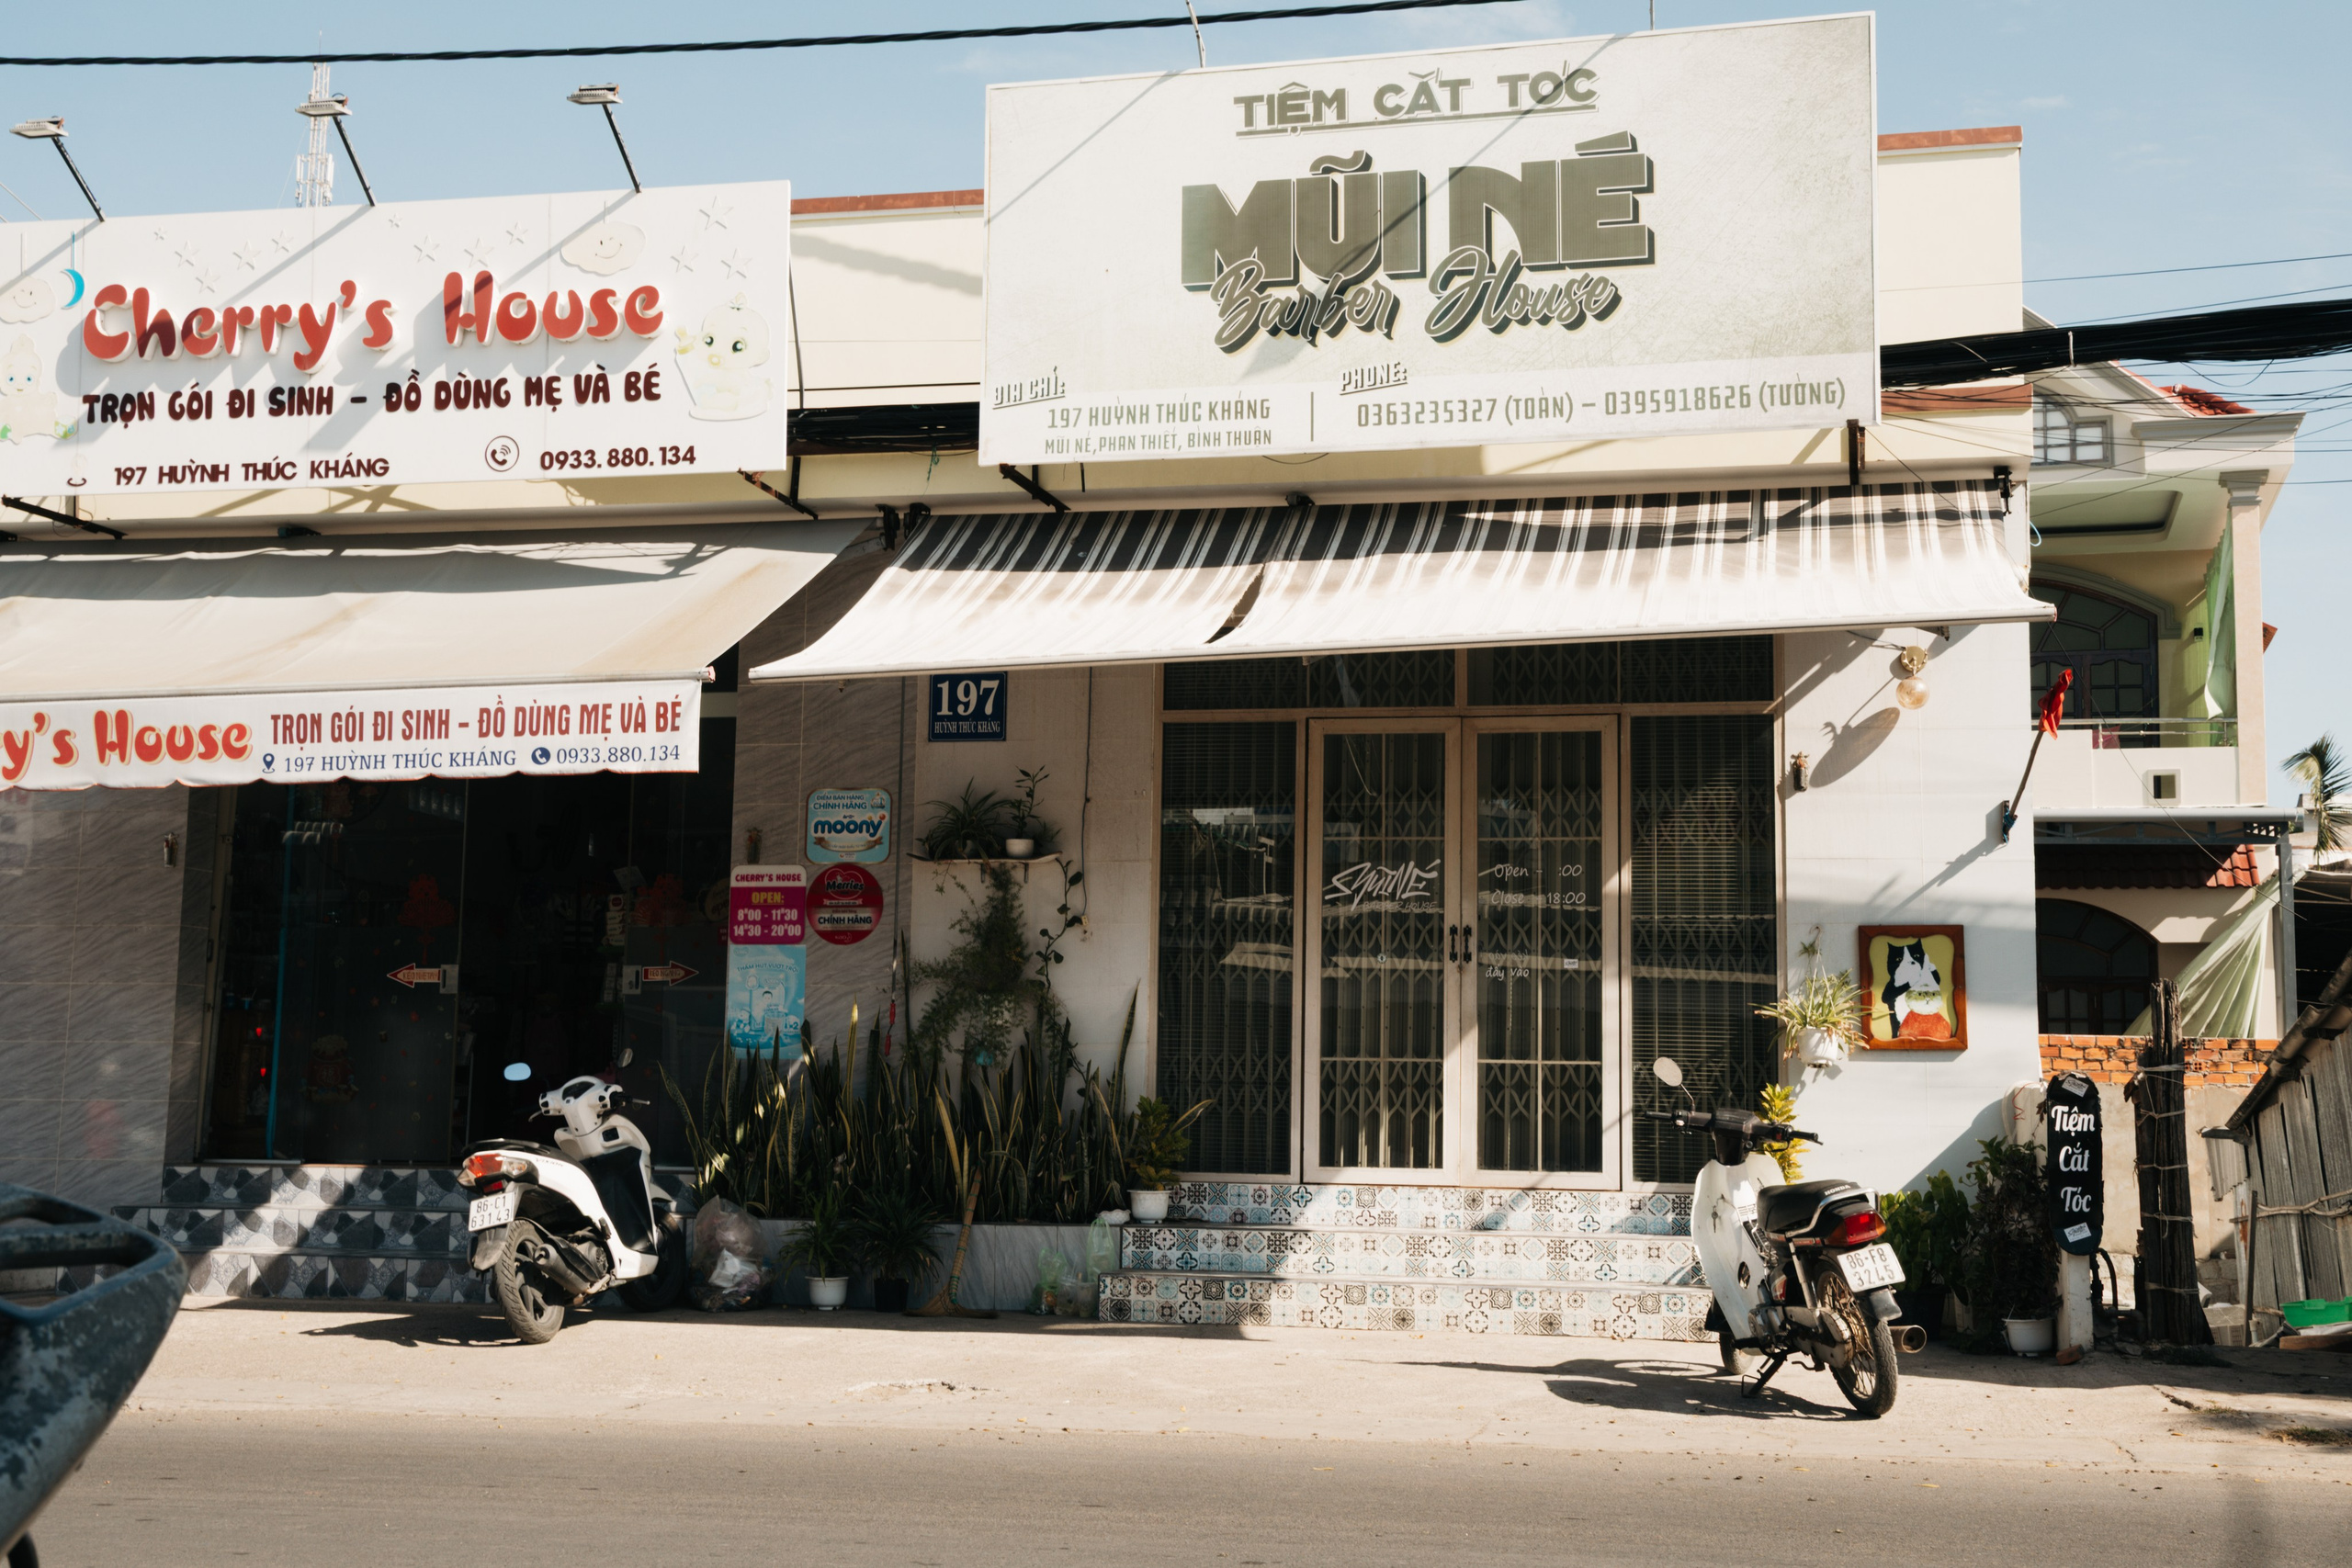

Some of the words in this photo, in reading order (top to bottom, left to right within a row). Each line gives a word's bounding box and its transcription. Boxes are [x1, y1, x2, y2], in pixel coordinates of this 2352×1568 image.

[1234, 81, 1348, 136] TIỆM
[1374, 67, 1473, 119] CẮT
[1182, 150, 1427, 291] MŨI
[1449, 130, 1656, 273] NÉ
[1210, 257, 1401, 355] Barber
[1424, 244, 1623, 348] House
[83, 279, 399, 375] Cherry's
[444, 270, 664, 346] House
[83, 391, 154, 429] TRỌN
[168, 382, 212, 421] GÓI
[226, 389, 254, 418] ĐI
[268, 386, 334, 416] SINH
[383, 369, 422, 412] ĐỒ
[434, 372, 511, 411] DÙNG
[525, 376, 562, 412] MẸ
[574, 364, 610, 404] VÀ
[624, 363, 661, 401] BÉ
[1047, 408, 1082, 429] 197
[1089, 396, 1149, 426] HUỲNH
[1156, 393, 1202, 423] THÚC
[1208, 390, 1271, 421] KHÁNG
[1358, 399, 1497, 427] 0363235327
[1505, 387, 1573, 425] (TOÀN)
[1605, 385, 1751, 415] 0395918626
[1045, 435, 1069, 454] MŨI
[1141, 426, 1182, 451] THIẾT,
[1188, 425, 1221, 447] BÌNH
[1226, 426, 1272, 447] THUẬN
[115, 467, 147, 486] 197
[158, 459, 230, 484] HUỲNH
[242, 457, 298, 481] THÚC
[310, 452, 390, 479] KHÁNG
[937, 680, 1000, 716] 197
[271, 713, 322, 750] TRỌN
[331, 705, 364, 743] GÓI
[372, 711, 393, 741] ĐI
[401, 709, 450, 740] SINH
[478, 694, 505, 738] ĐỒ
[514, 699, 571, 737] DÙNG
[579, 704, 612, 741] MẸ
[620, 695, 646, 734] VÀ
[655, 694, 682, 732] BÉ
[934, 718, 957, 733] HUỲNH
[959, 718, 977, 733] THÚC
[978, 717, 1001, 733] KHÁNG
[1, 711, 79, 782] y's
[94, 709, 253, 766] House
[557, 745, 680, 764] 0933.880.134
[285, 757, 315, 773] 197
[322, 750, 386, 771] HUỲNH
[392, 748, 442, 769] THÚC
[449, 746, 516, 768] KHÁNG
[813, 801, 840, 810] CHÍNH
[814, 818, 884, 838] moony
[735, 874, 773, 882] CHERRY'S
[776, 874, 802, 882] HOUSE
[826, 880, 865, 891] Merries
[1495, 864, 1529, 881] Open
[752, 891, 785, 905] OPEN:
[1405, 901, 1438, 911] HOUSE
[1492, 889, 1525, 905] Close
[1547, 892, 1587, 904] 18:00
[818, 914, 845, 925] CHÍNH
[2051, 1105, 2096, 1137] Tiệm
[2059, 1142, 2090, 1172] Cắt
[1824, 1184, 1852, 1196] HONDA
[2061, 1187, 2092, 1213] Tóc
[477, 1195, 506, 1213] 86-C1
